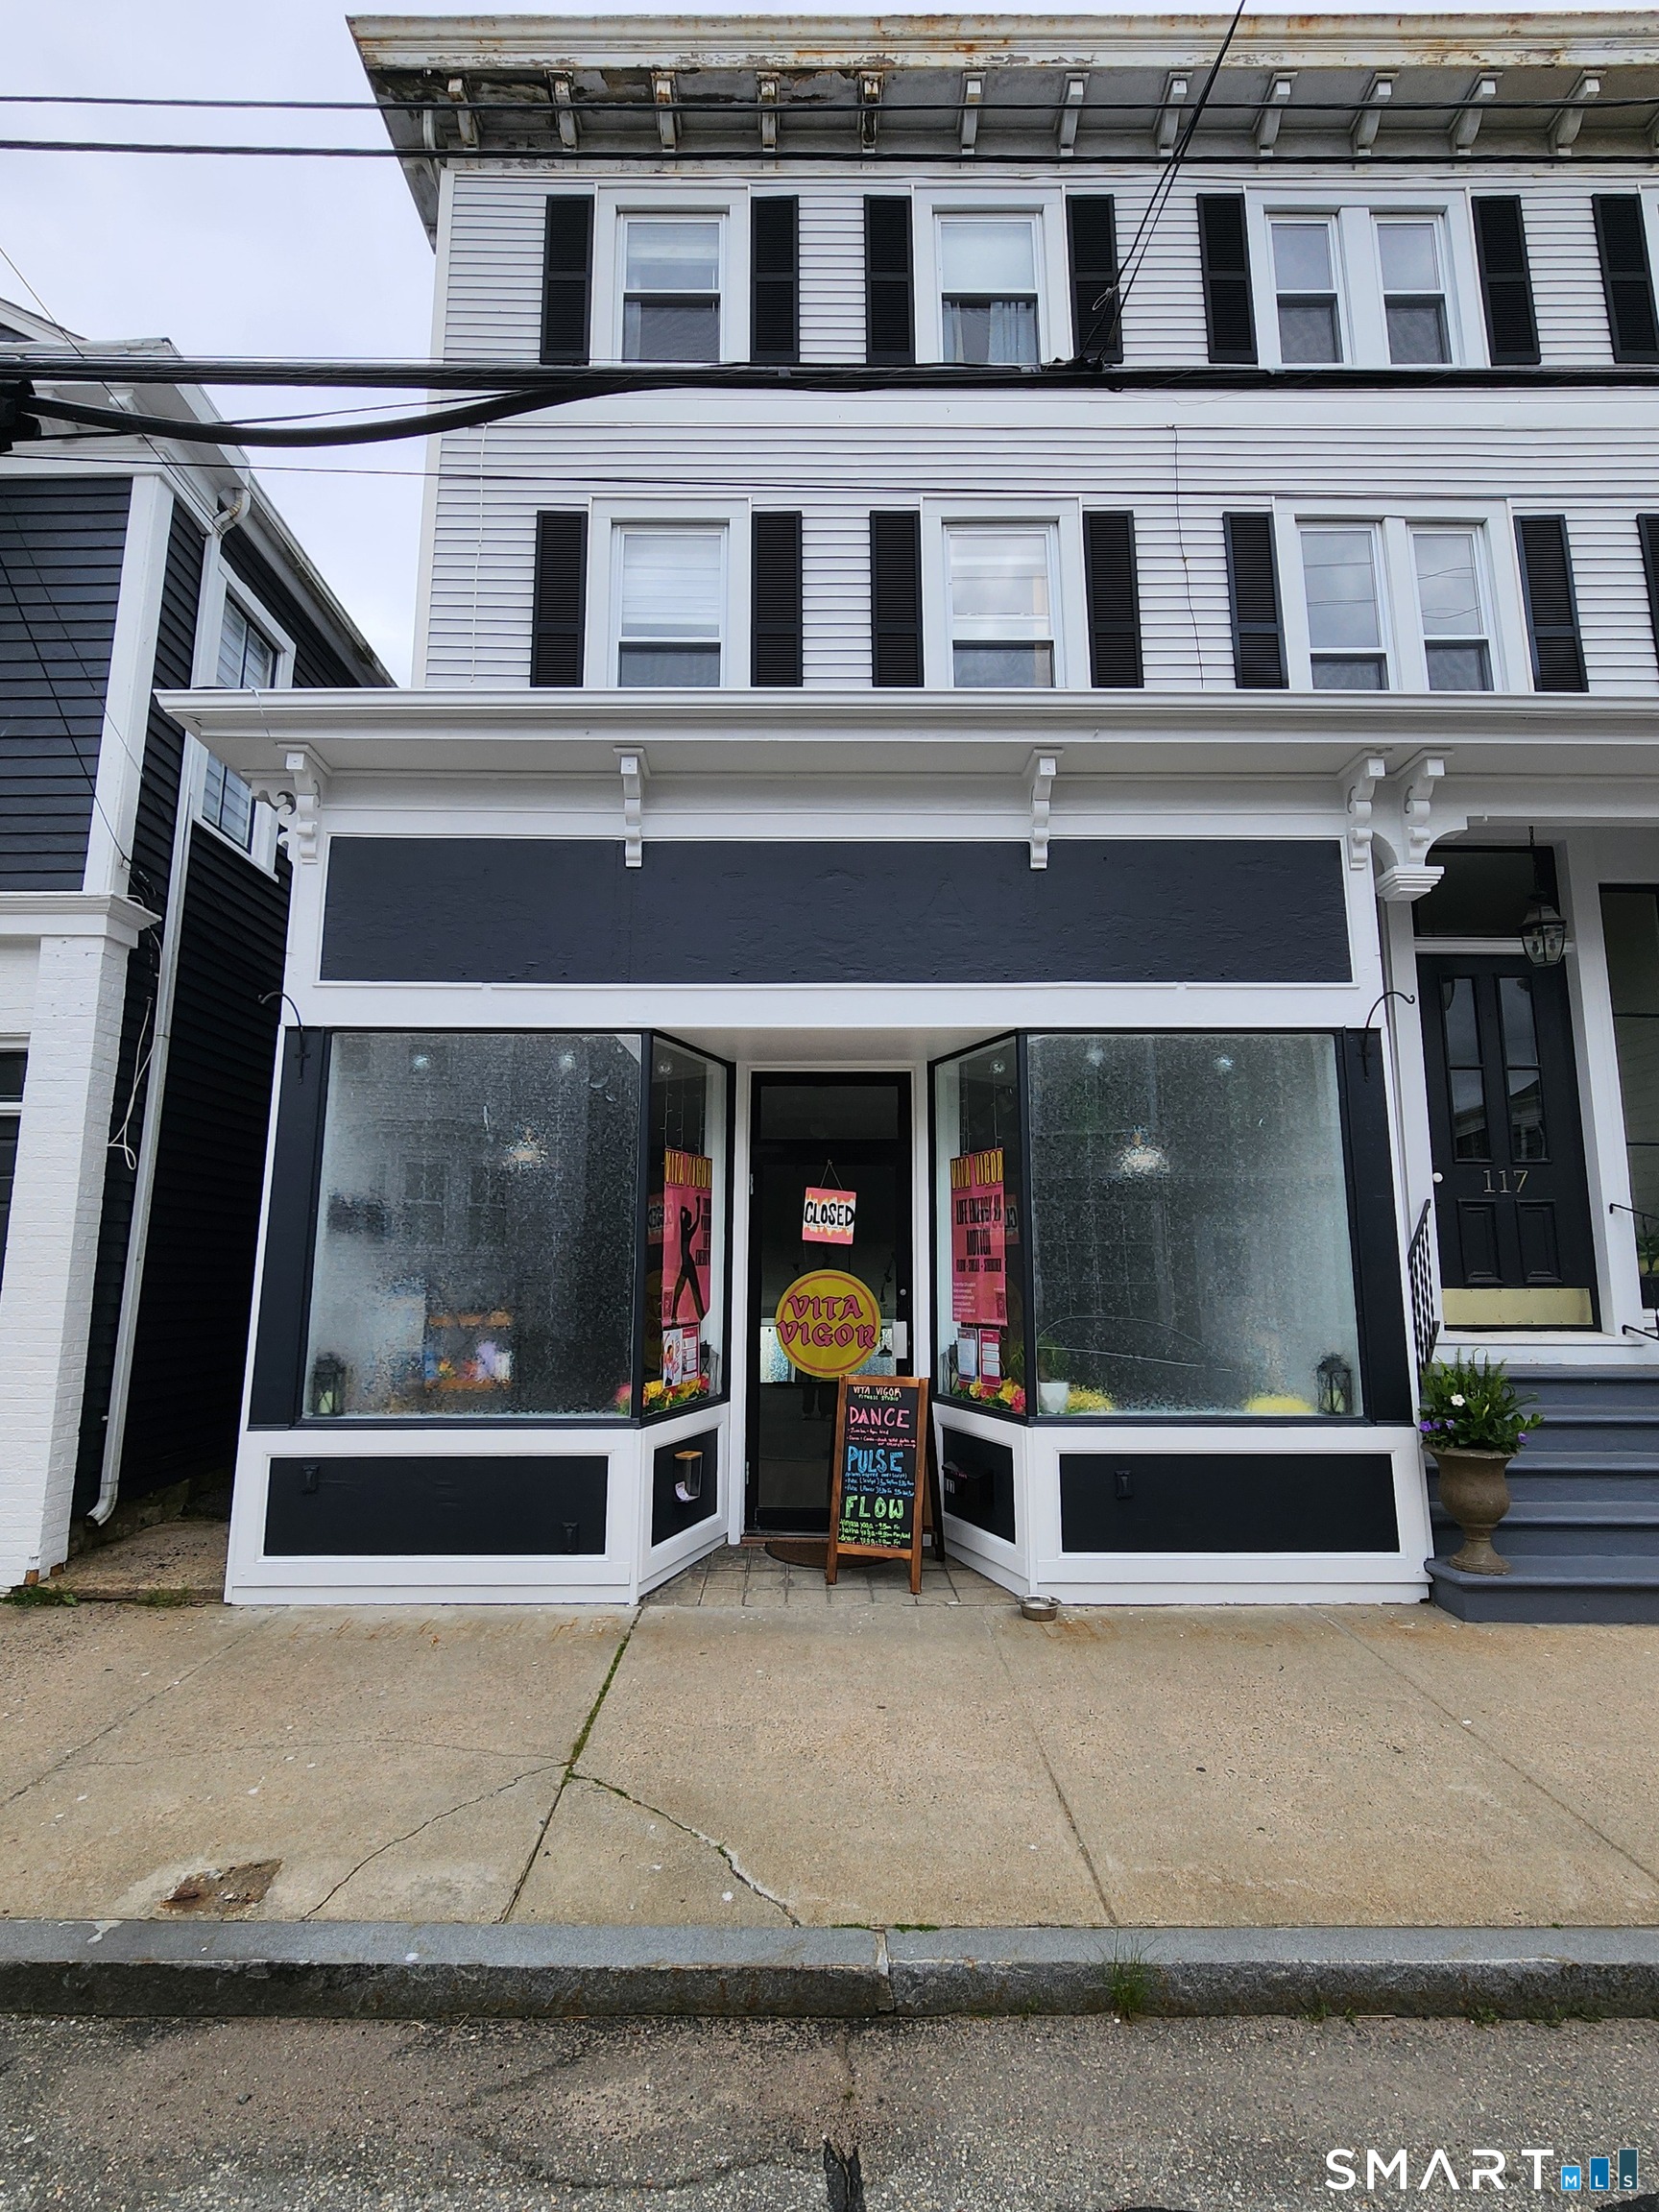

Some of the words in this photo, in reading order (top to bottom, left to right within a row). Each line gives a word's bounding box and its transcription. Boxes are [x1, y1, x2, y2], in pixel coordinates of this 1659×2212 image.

[665, 1150, 685, 1186] VITA
[686, 1155, 712, 1190] VIGOR
[950, 1157, 971, 1190] VITA
[974, 1149, 1004, 1187] VIGOR
[1483, 1169, 1528, 1193] 117
[805, 1201, 855, 1227] CLOSED
[787, 1294, 863, 1321] VITA
[777, 1320, 878, 1350] VIGOR
[853, 1385, 871, 1395] VITA
[876, 1386, 902, 1399] VIGOR
[850, 1406, 910, 1429] DANCE
[847, 1445, 904, 1474] PULSE
[845, 1495, 904, 1519] FLOW
